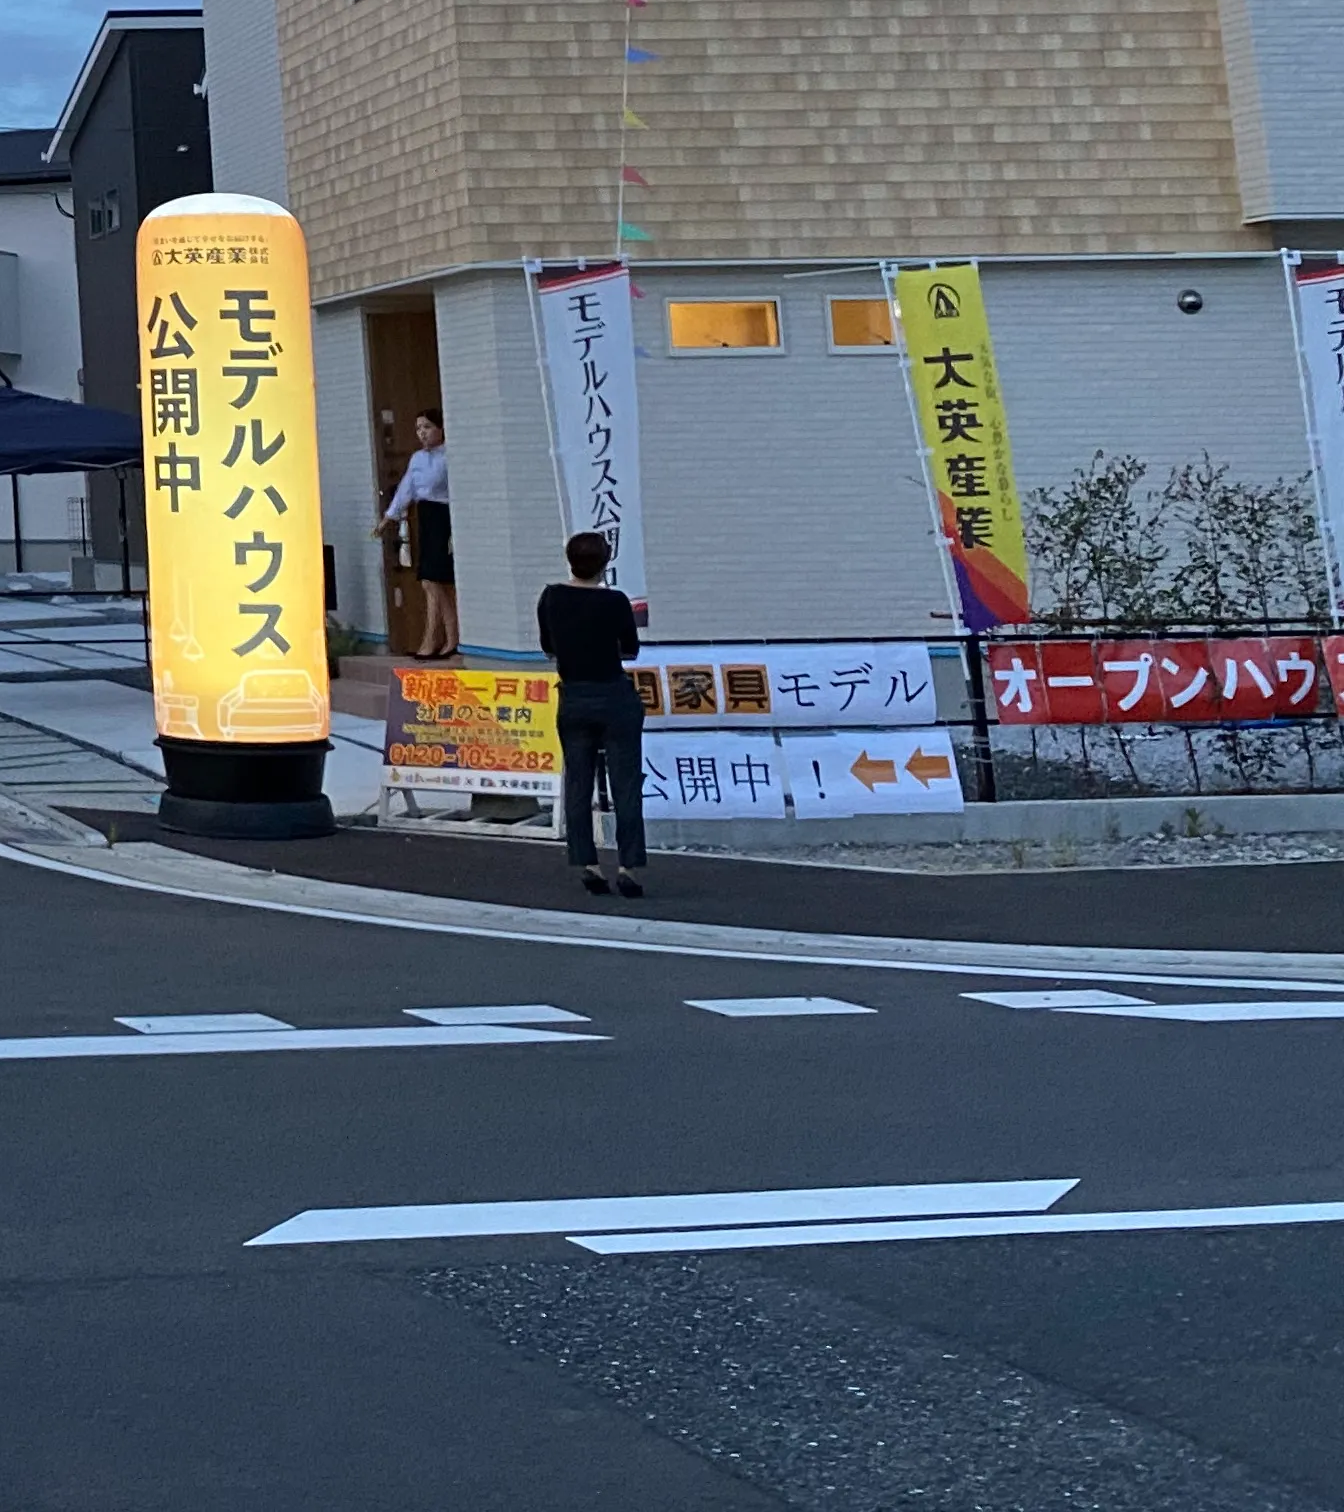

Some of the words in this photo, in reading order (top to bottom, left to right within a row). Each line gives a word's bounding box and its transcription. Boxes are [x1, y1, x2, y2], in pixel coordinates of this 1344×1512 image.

[146, 290, 202, 514] 公開中
[923, 347, 993, 550] 大英産業
[219, 289, 291, 658] モデルハウス
[401, 673, 549, 704] 新築一戸建
[994, 652, 1344, 713] オープンハウ
[389, 743, 555, 771] 0120-105-282
